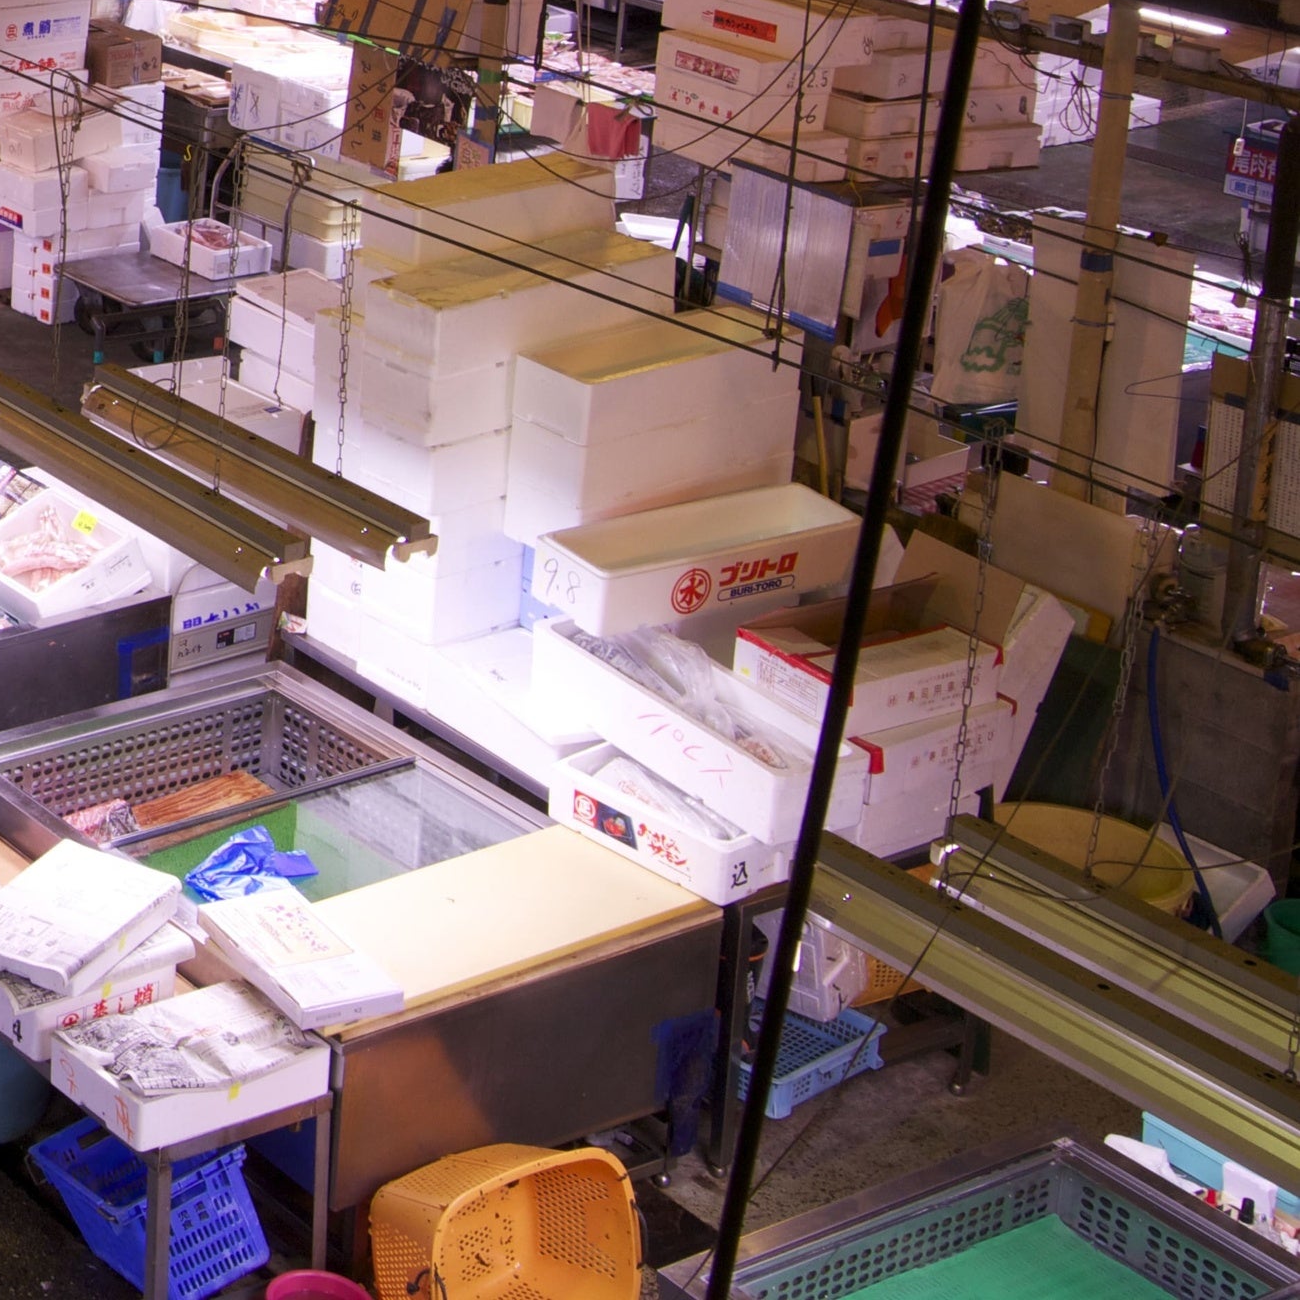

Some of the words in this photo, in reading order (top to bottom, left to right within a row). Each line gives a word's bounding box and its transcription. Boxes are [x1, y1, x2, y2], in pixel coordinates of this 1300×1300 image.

[543, 557, 582, 605] 9.8
[719, 552, 799, 587] ブリトロ
[729, 579, 783, 598] BURI-TORO
[731, 860, 748, 889] 込
